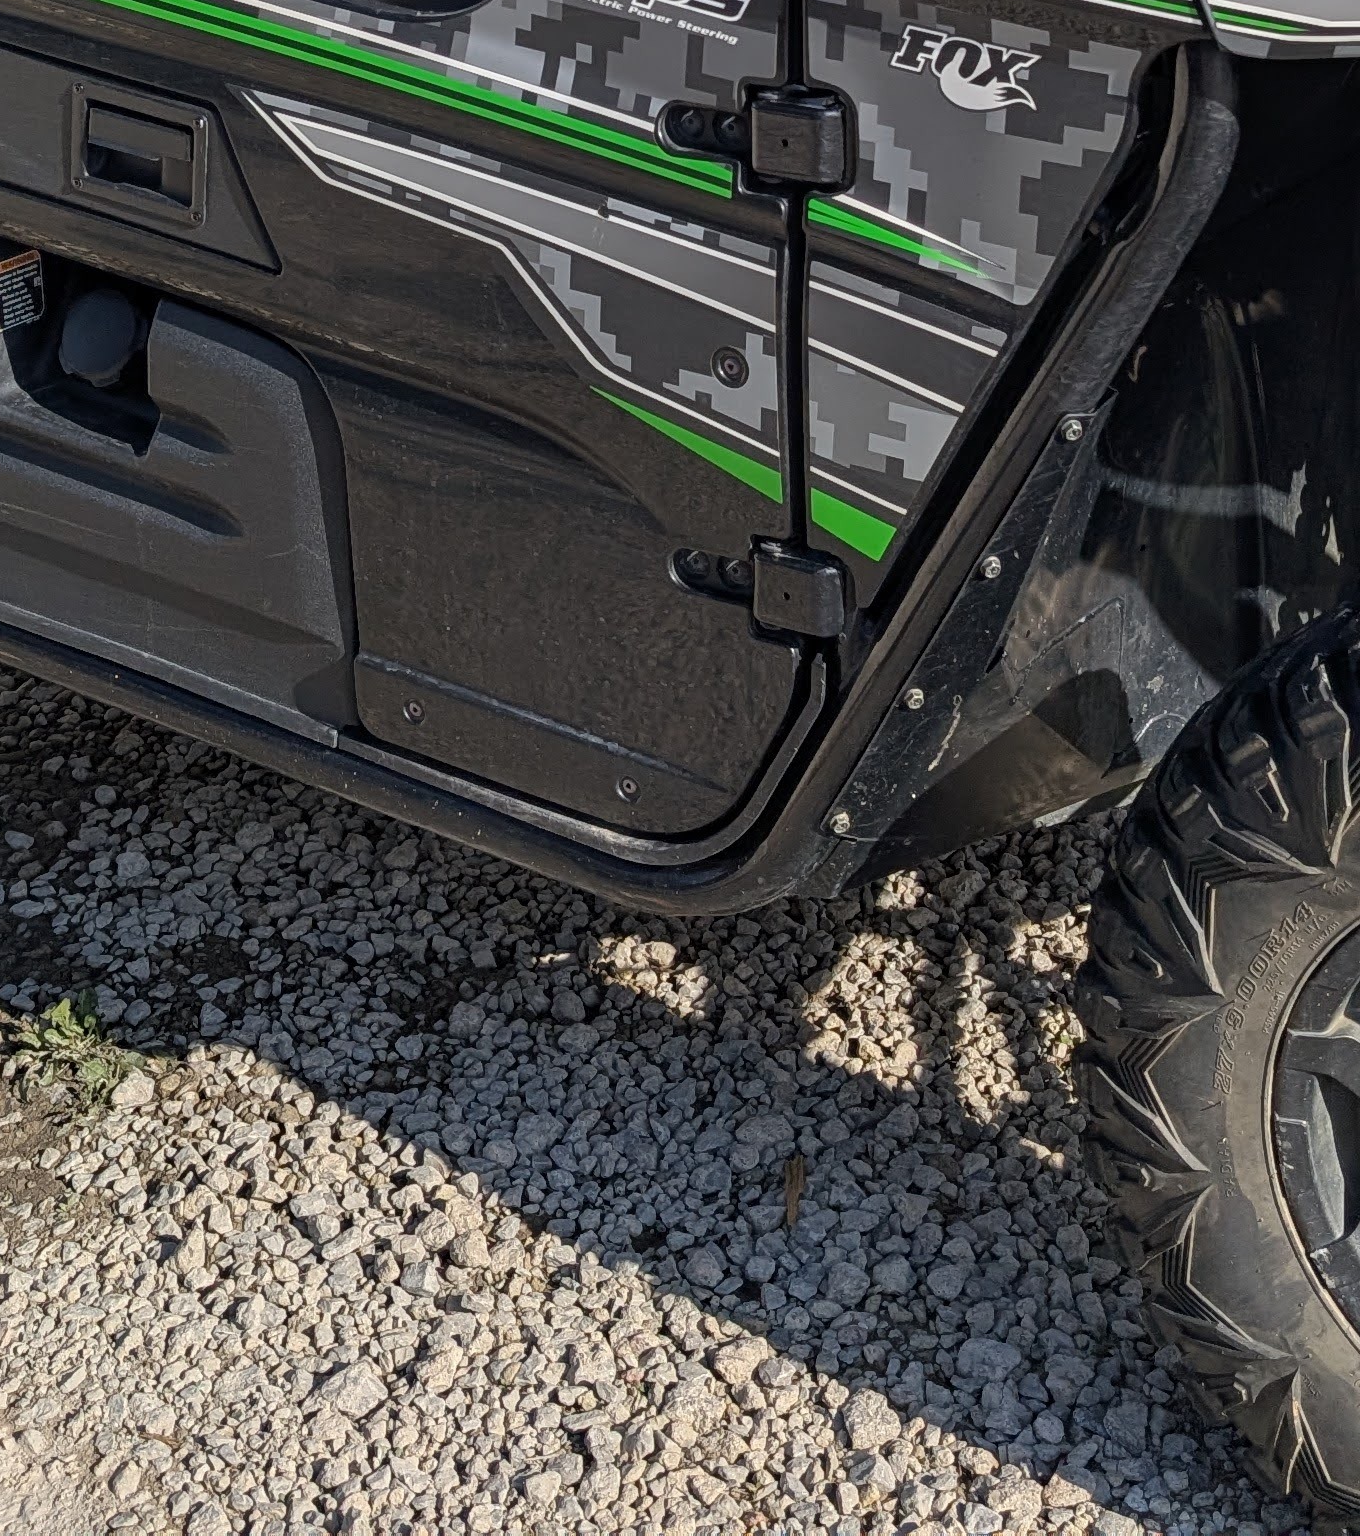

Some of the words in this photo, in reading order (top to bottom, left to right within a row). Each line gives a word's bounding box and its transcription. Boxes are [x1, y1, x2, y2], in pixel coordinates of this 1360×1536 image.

[628, 5, 673, 25] Power
[676, 19, 739, 46] Steering
[890, 25, 1042, 98] FOX
